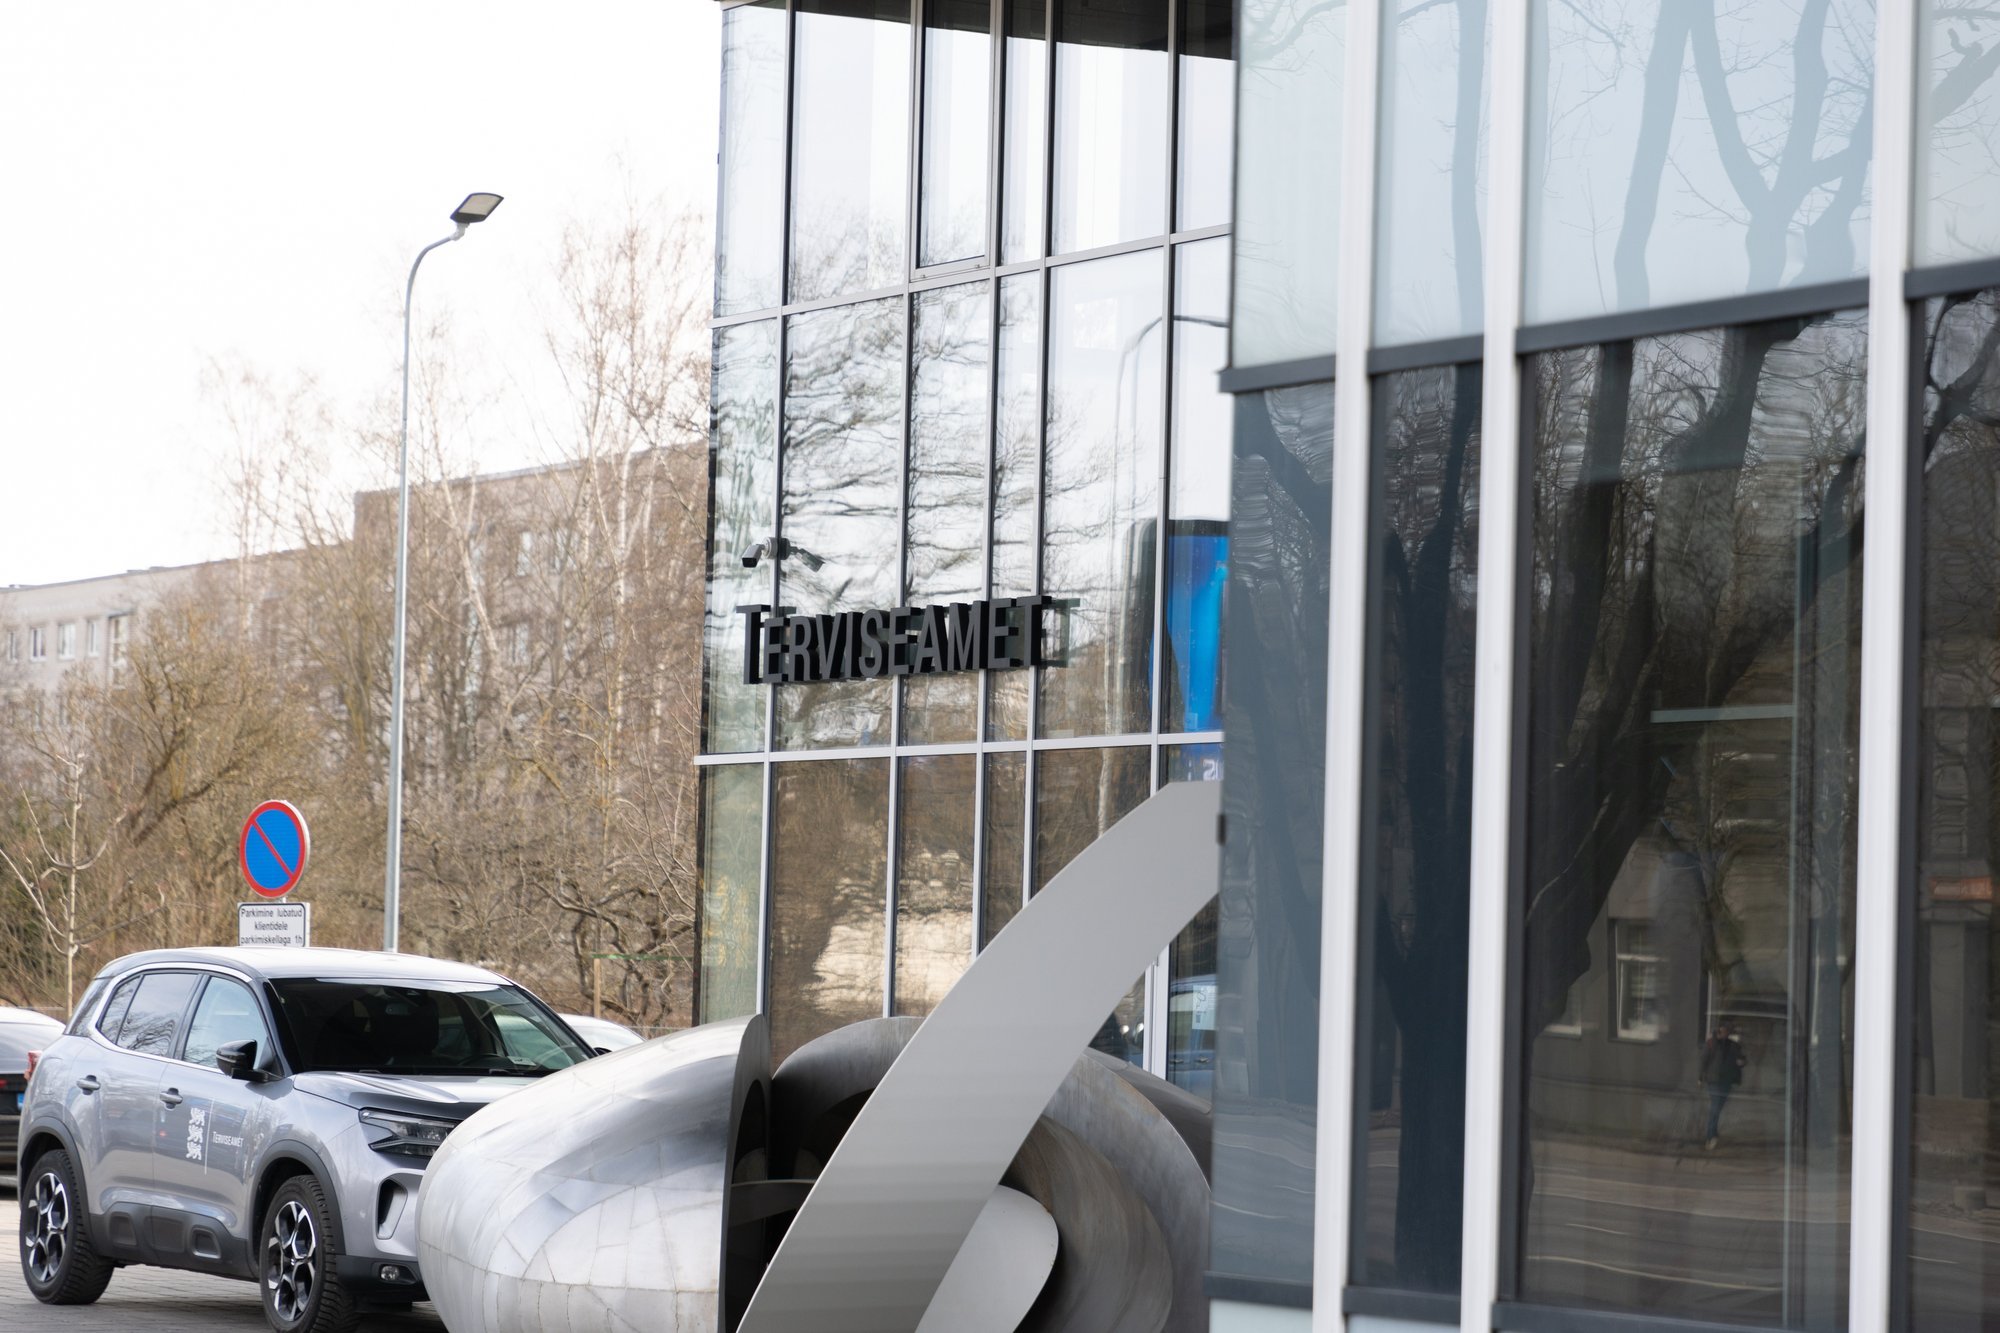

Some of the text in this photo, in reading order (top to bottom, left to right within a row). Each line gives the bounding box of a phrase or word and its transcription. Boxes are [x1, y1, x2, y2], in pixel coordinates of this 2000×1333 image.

[736, 595, 1049, 684] TERVISEAMET
[241, 908, 302, 917] Parkimine lubatud
[254, 921, 288, 930] klientidele
[241, 935, 303, 946] parkimiskellaga 1h
